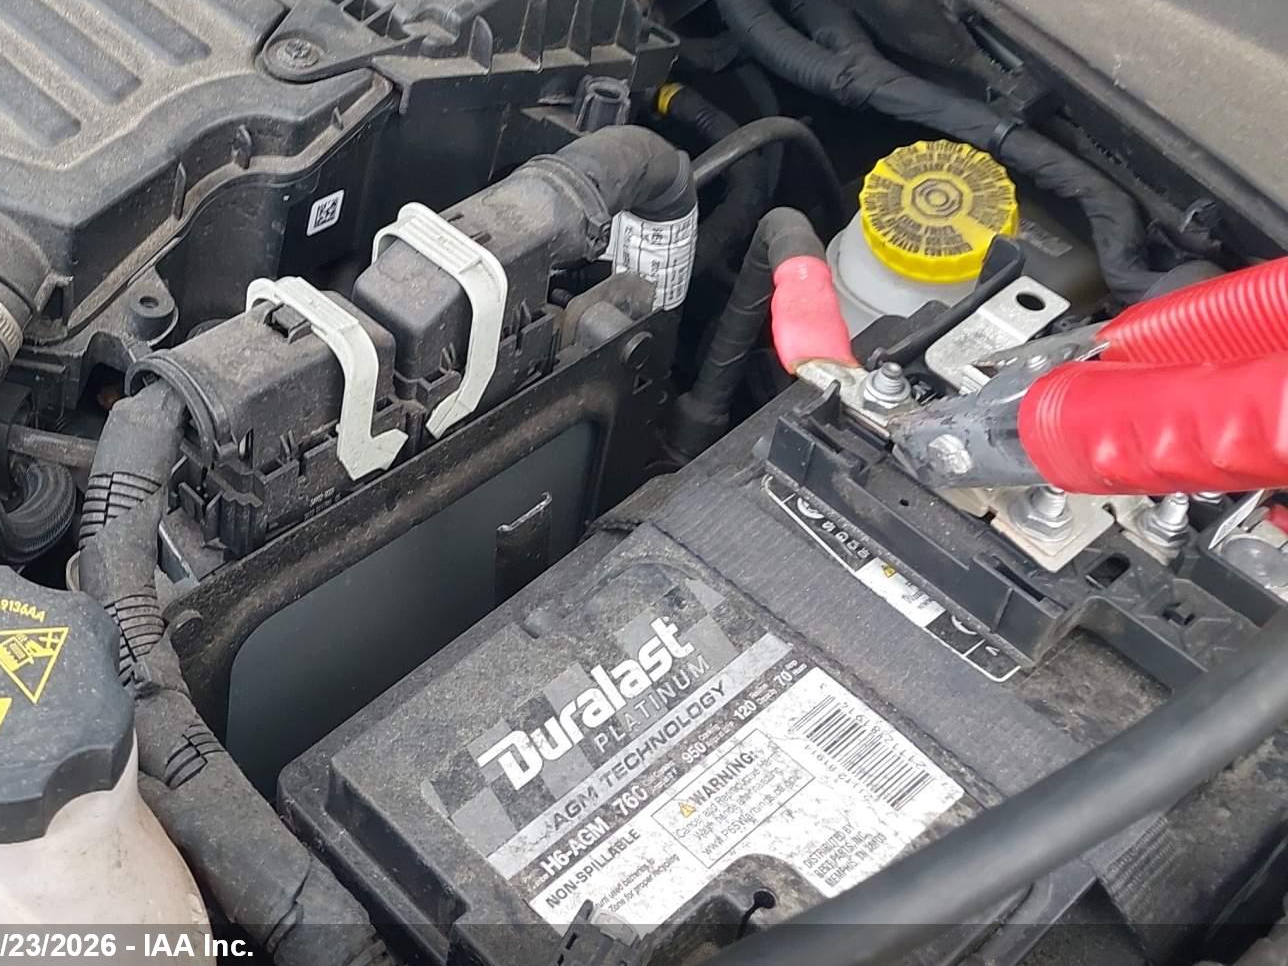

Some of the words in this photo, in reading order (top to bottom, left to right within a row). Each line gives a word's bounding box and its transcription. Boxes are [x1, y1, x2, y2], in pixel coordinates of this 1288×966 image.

[475, 613, 695, 791] Duralast
[591, 652, 712, 754] PLATINUM
[539, 812, 611, 876] H6-AGM
[612, 782, 650, 817] 760
[680, 739, 708, 766] 950
[732, 697, 758, 723] 120
[773, 667, 793, 688] 70
[546, 782, 600, 830] AGM
[599, 679, 729, 789] TECHNOLOGY
[688, 747, 758, 807] WARNING:
[544, 827, 641, 909] NON-SPILLABLE
[801, 828, 846, 869] DISTRIBUTED
[842, 821, 854, 834] BY
